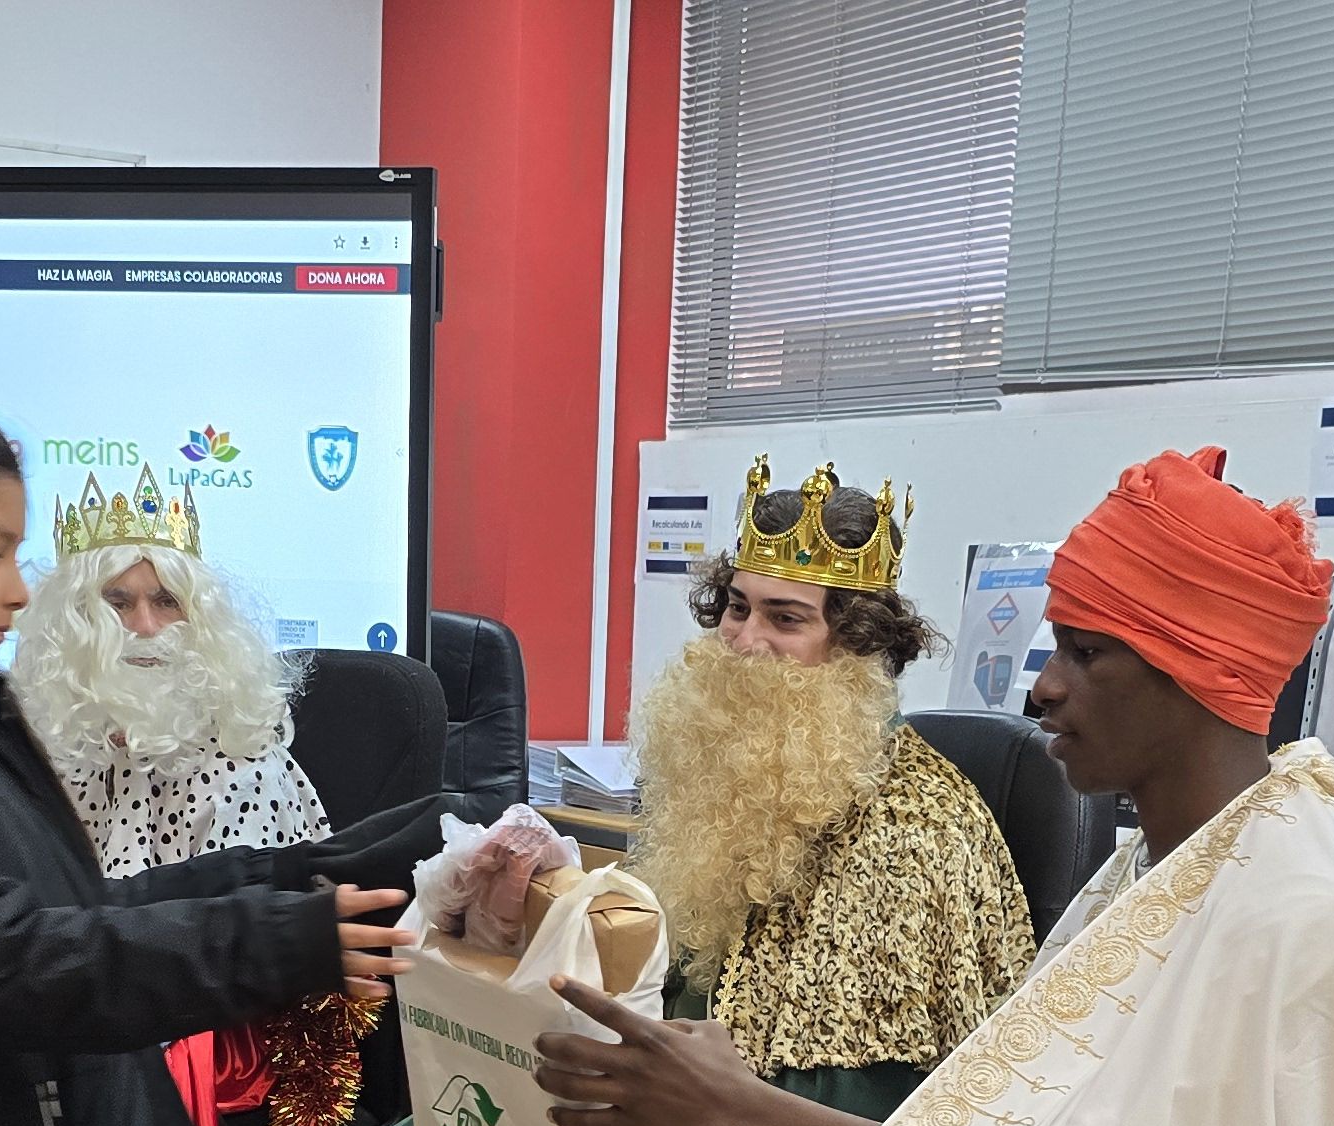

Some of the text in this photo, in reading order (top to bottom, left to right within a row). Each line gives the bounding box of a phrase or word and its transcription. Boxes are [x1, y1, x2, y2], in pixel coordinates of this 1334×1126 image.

[37, 268, 114, 282] HAZ LA MAGIA
[125, 270, 283, 284] EMPRESAS COLABORADORAS
[308, 272, 386, 286] DONA AHORA
[43, 437, 140, 467] meins
[168, 467, 254, 489] LuPaGAS
[408, 1004, 450, 1039] FABRICADA
